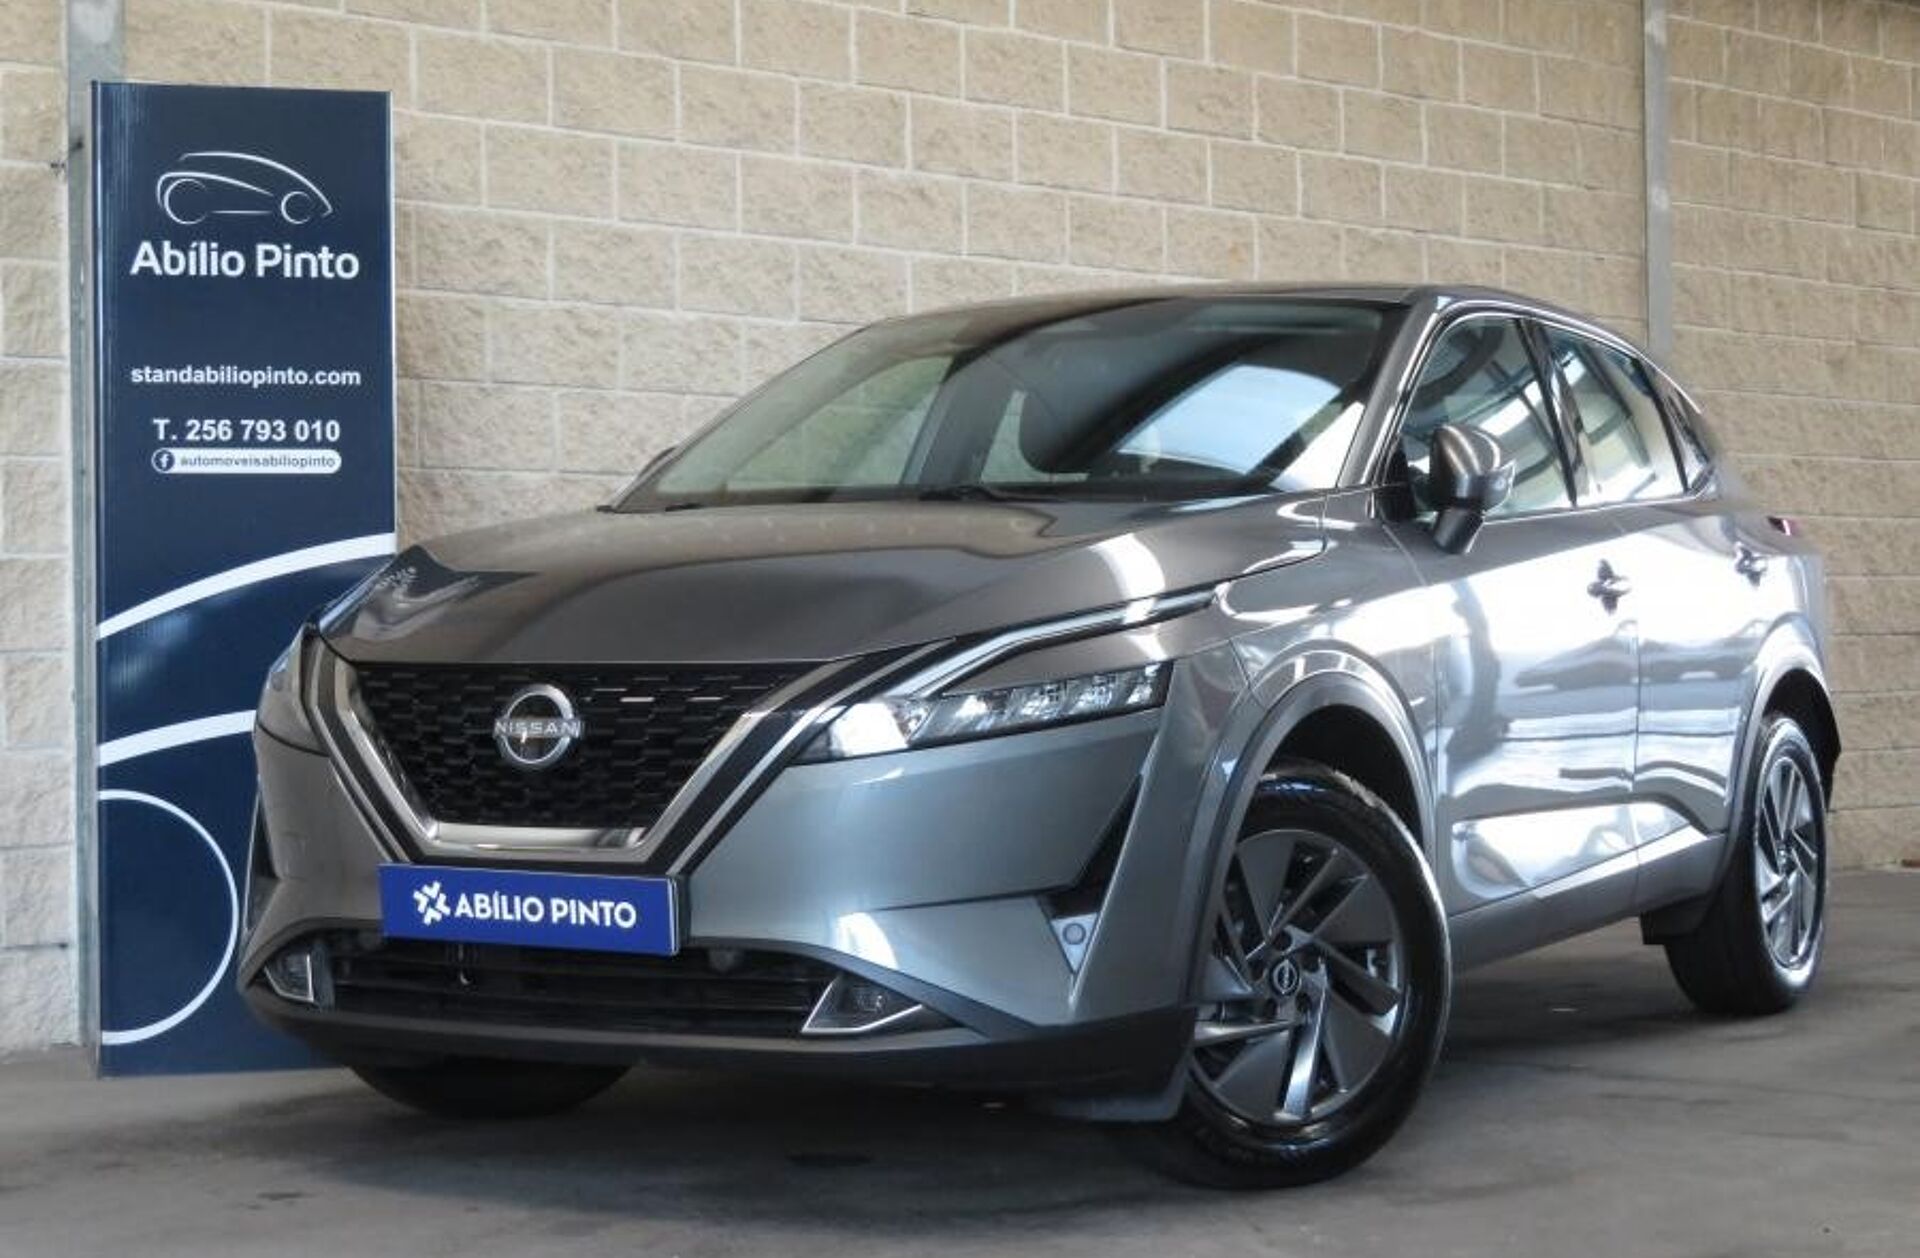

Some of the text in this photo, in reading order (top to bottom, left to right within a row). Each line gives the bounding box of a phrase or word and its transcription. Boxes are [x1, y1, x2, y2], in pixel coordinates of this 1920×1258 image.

[129, 240, 360, 280] Abílio Pinto
[130, 364, 361, 389] standabiliopinto.com
[152, 418, 341, 442] T. 256 793 010
[180, 455, 334, 470] automoveisabiliopinto
[494, 721, 579, 736] NISSAN
[454, 890, 637, 928] ABÍLIO PINTO
